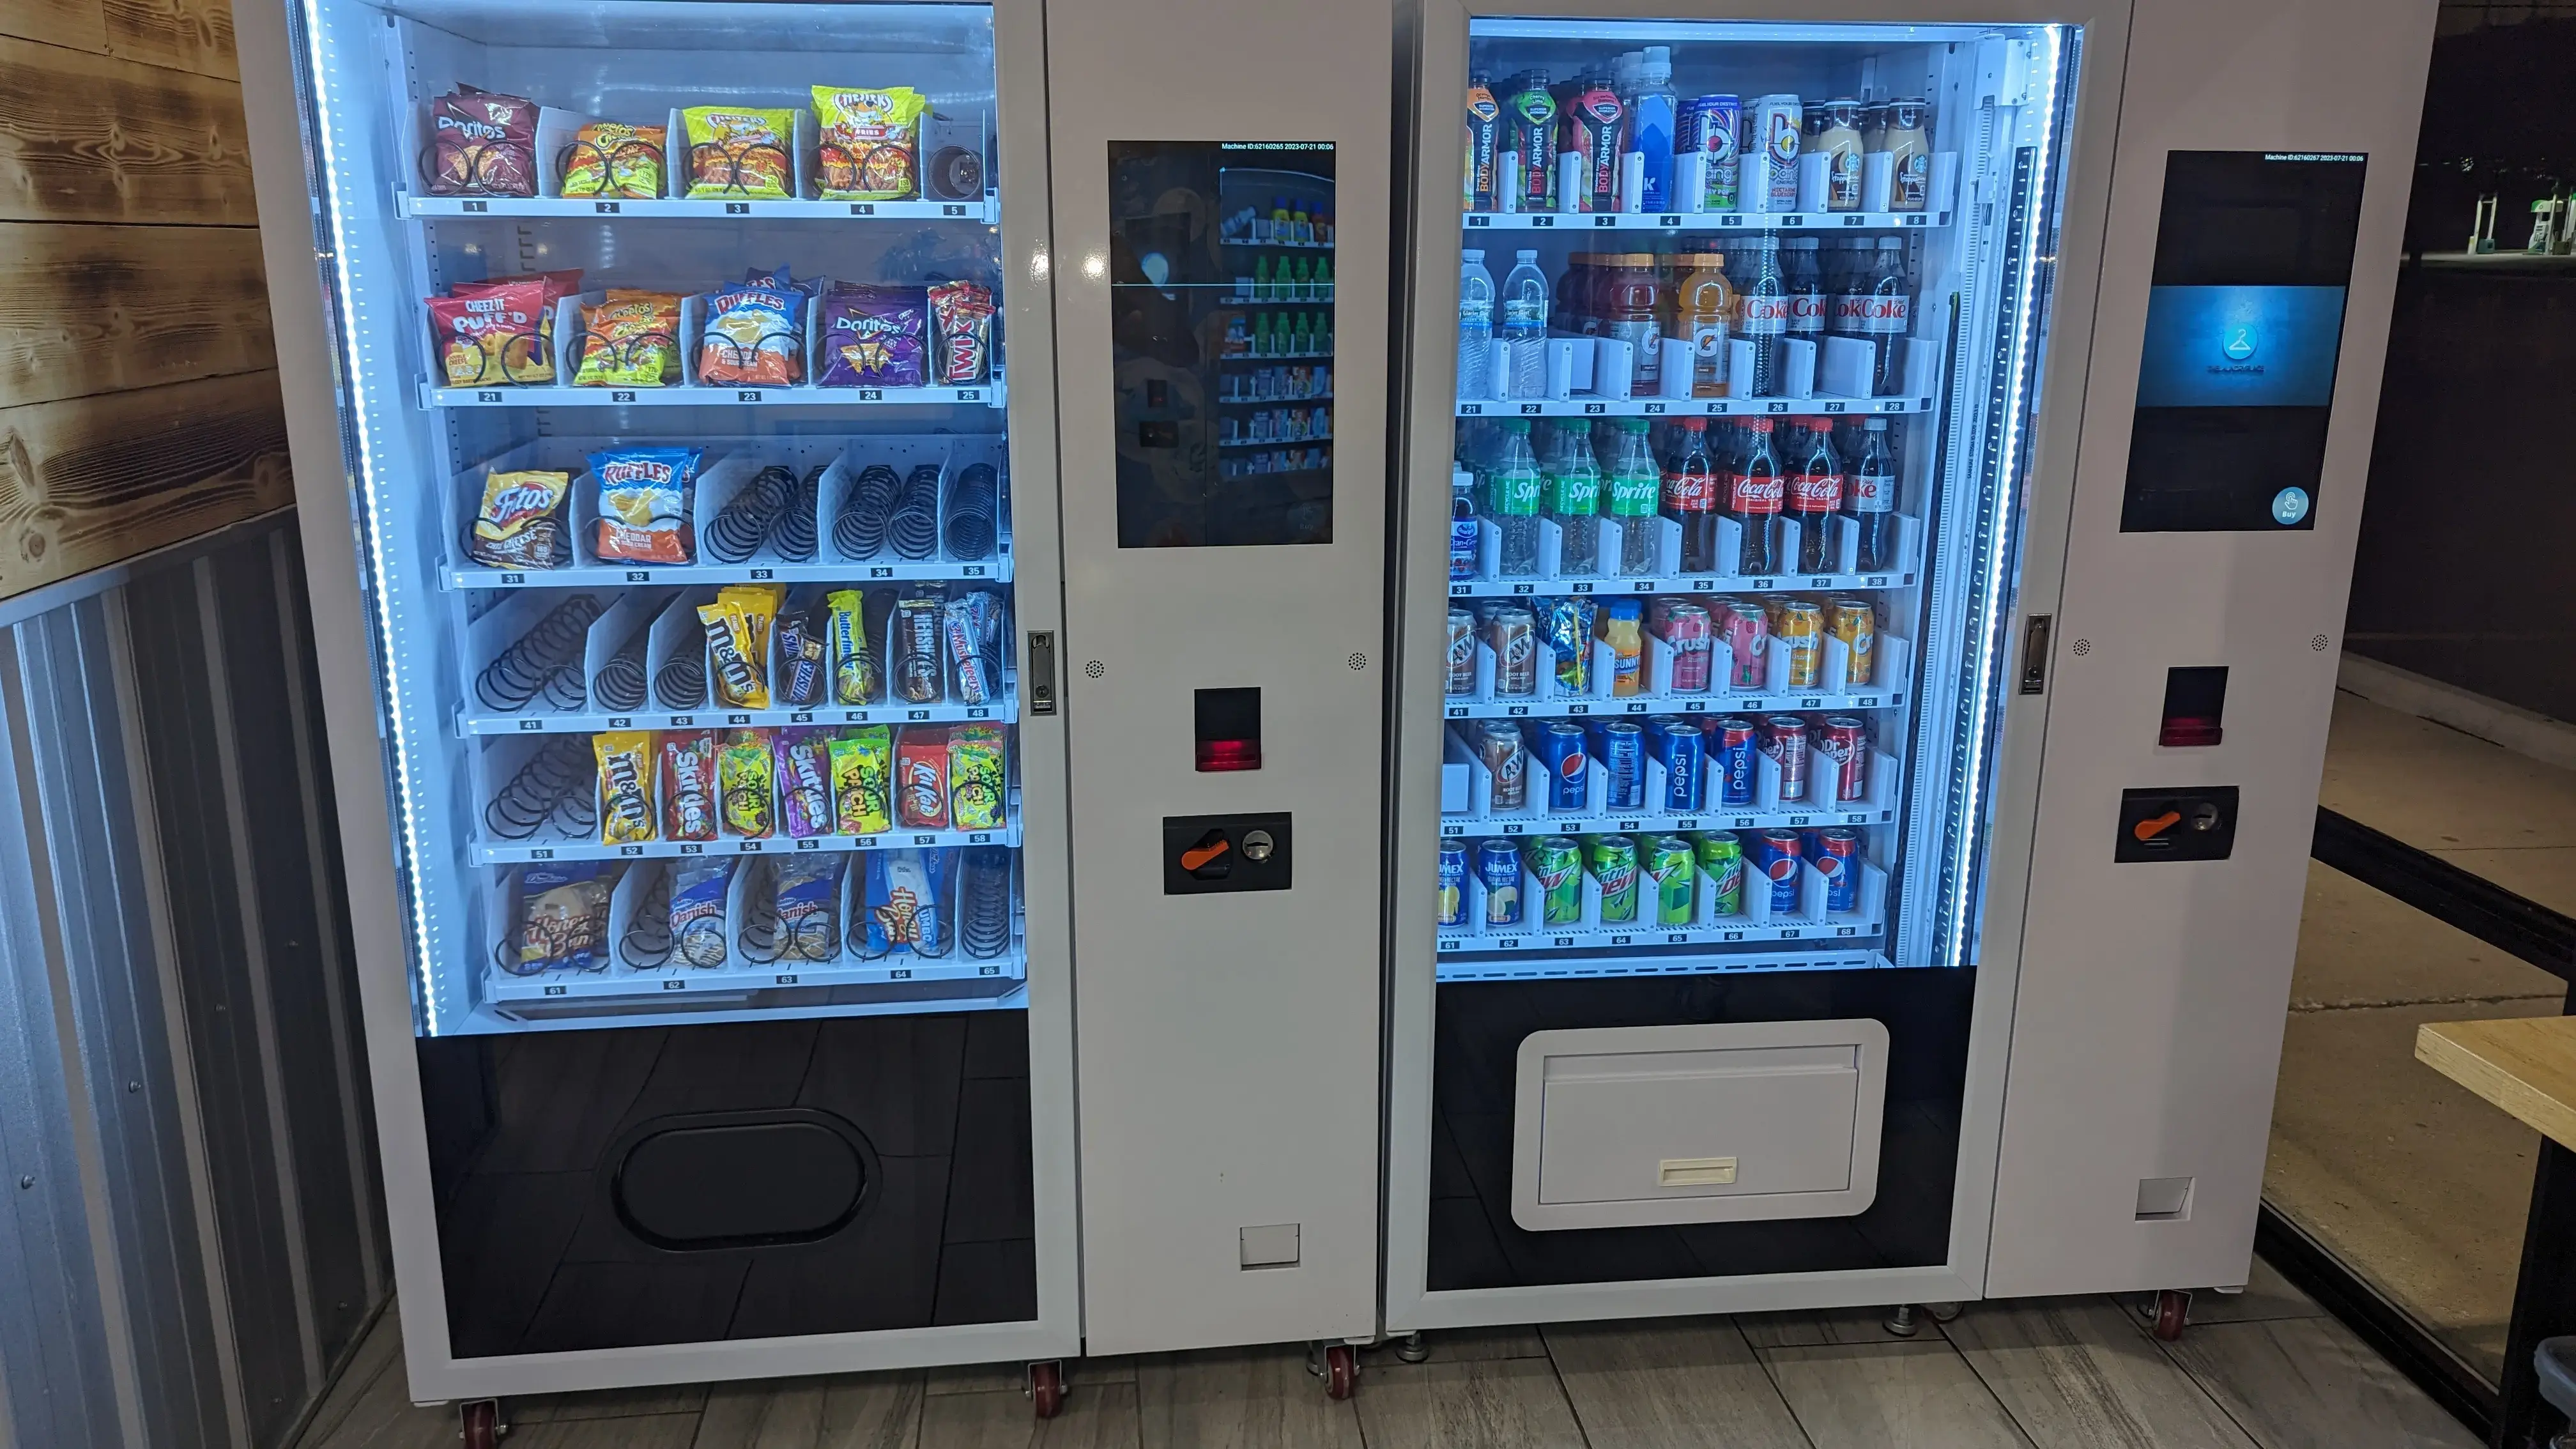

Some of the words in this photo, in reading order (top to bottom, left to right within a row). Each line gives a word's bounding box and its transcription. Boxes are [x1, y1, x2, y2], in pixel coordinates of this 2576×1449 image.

[438, 116, 506, 139] Doritos
[1480, 123, 1492, 192] BODYARMOR
[1531, 127, 1543, 194] BODYARMOR
[1598, 125, 1612, 193] BODYARMOR
[471, 202, 478, 211] 1
[604, 203, 611, 213] 2
[734, 204, 741, 213] 3
[859, 205, 866, 214] 4
[951, 206, 958, 215] 5
[1476, 217, 1482, 226] 1
[1540, 217, 1546, 226] 2
[1602, 217, 1608, 226] 3
[1667, 217, 1673, 226] 4
[1729, 217, 1735, 225] 5
[1789, 217, 1795, 225] 6
[1851, 217, 1857, 225] 7
[1913, 216, 1920, 224] 8
[1862, 298, 1906, 319] Coke
[452, 311, 528, 334] PUFF'D
[836, 316, 901, 334] Doritos
[949, 319, 978, 381] TWIX
[484, 392, 496, 401] 21
[617, 392, 631, 401] 22
[744, 392, 756, 401] 23
[864, 391, 877, 400] 24
[962, 391, 975, 399] 25
[1466, 405, 1476, 413] 21
[1526, 405, 1537, 413] 22
[1589, 404, 1600, 413] 23
[1649, 404, 1660, 413] 24
[1712, 404, 1722, 412] 25
[1772, 403, 1784, 411] 26
[1829, 403, 1840, 411] 27
[1889, 402, 1900, 411] 28
[603, 460, 673, 486] RUFFLES
[1791, 477, 1838, 496] Coca-Cola
[1612, 481, 1655, 502] Sprite
[755, 570, 768, 579] 33
[875, 569, 888, 577] 34
[968, 567, 980, 575] 35
[506, 574, 519, 583] 31
[631, 572, 645, 581] 32
[1758, 580, 1768, 588] 36
[1871, 578, 1883, 586] 38
[1456, 586, 1466, 594] 31
[795, 714, 808, 722] 45
[913, 711, 924, 719] 47
[613, 719, 626, 727] 42
[676, 717, 688, 725] 43
[733, 716, 746, 724] 44
[1825, 739, 1841, 752] Dr
[1732, 747, 1747, 791] pepsi
[1673, 753, 1687, 798] pepsi
[747, 770, 762, 809] SOUR
[790, 745, 828, 829] Skittles
[860, 766, 881, 813] SOUR
[1563, 783, 1585, 795] pepsi
[675, 750, 702, 834] Skittles
[974, 834, 986, 843] 58
[625, 847, 638, 855] 52
[1485, 861, 1518, 873] JUMEX
[671, 901, 717, 928] Danish
